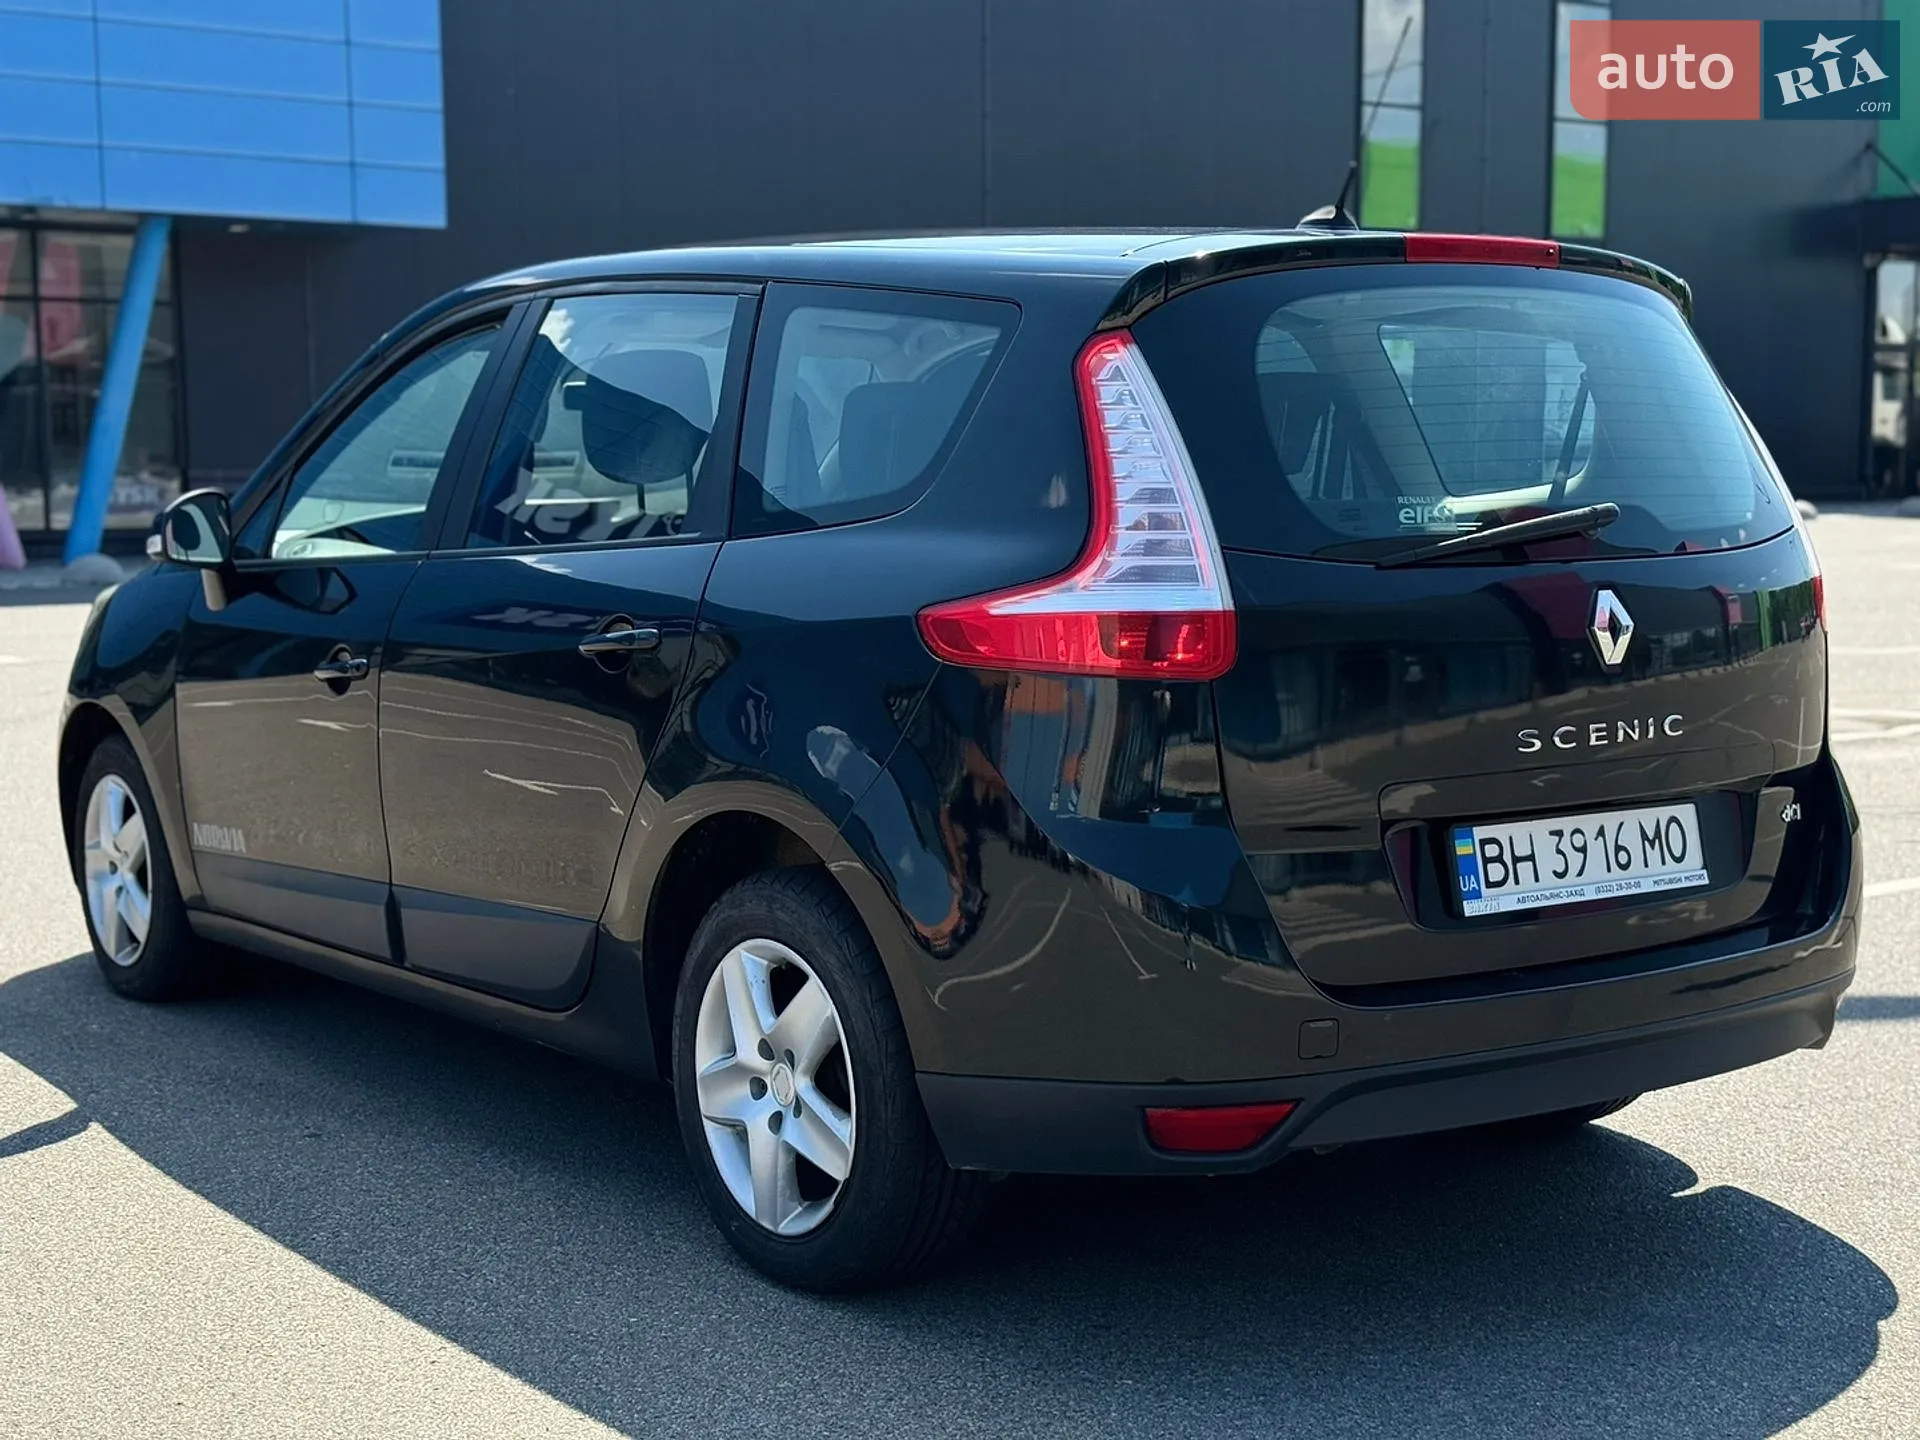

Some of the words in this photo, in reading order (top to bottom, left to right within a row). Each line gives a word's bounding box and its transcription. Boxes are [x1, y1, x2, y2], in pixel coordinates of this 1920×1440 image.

[1517, 714, 1684, 752] SCENIC
[1479, 833, 1540, 889] BH
[1549, 821, 1632, 879] 3916
[1638, 815, 1688, 869] MO
[1459, 875, 1479, 892] UA
